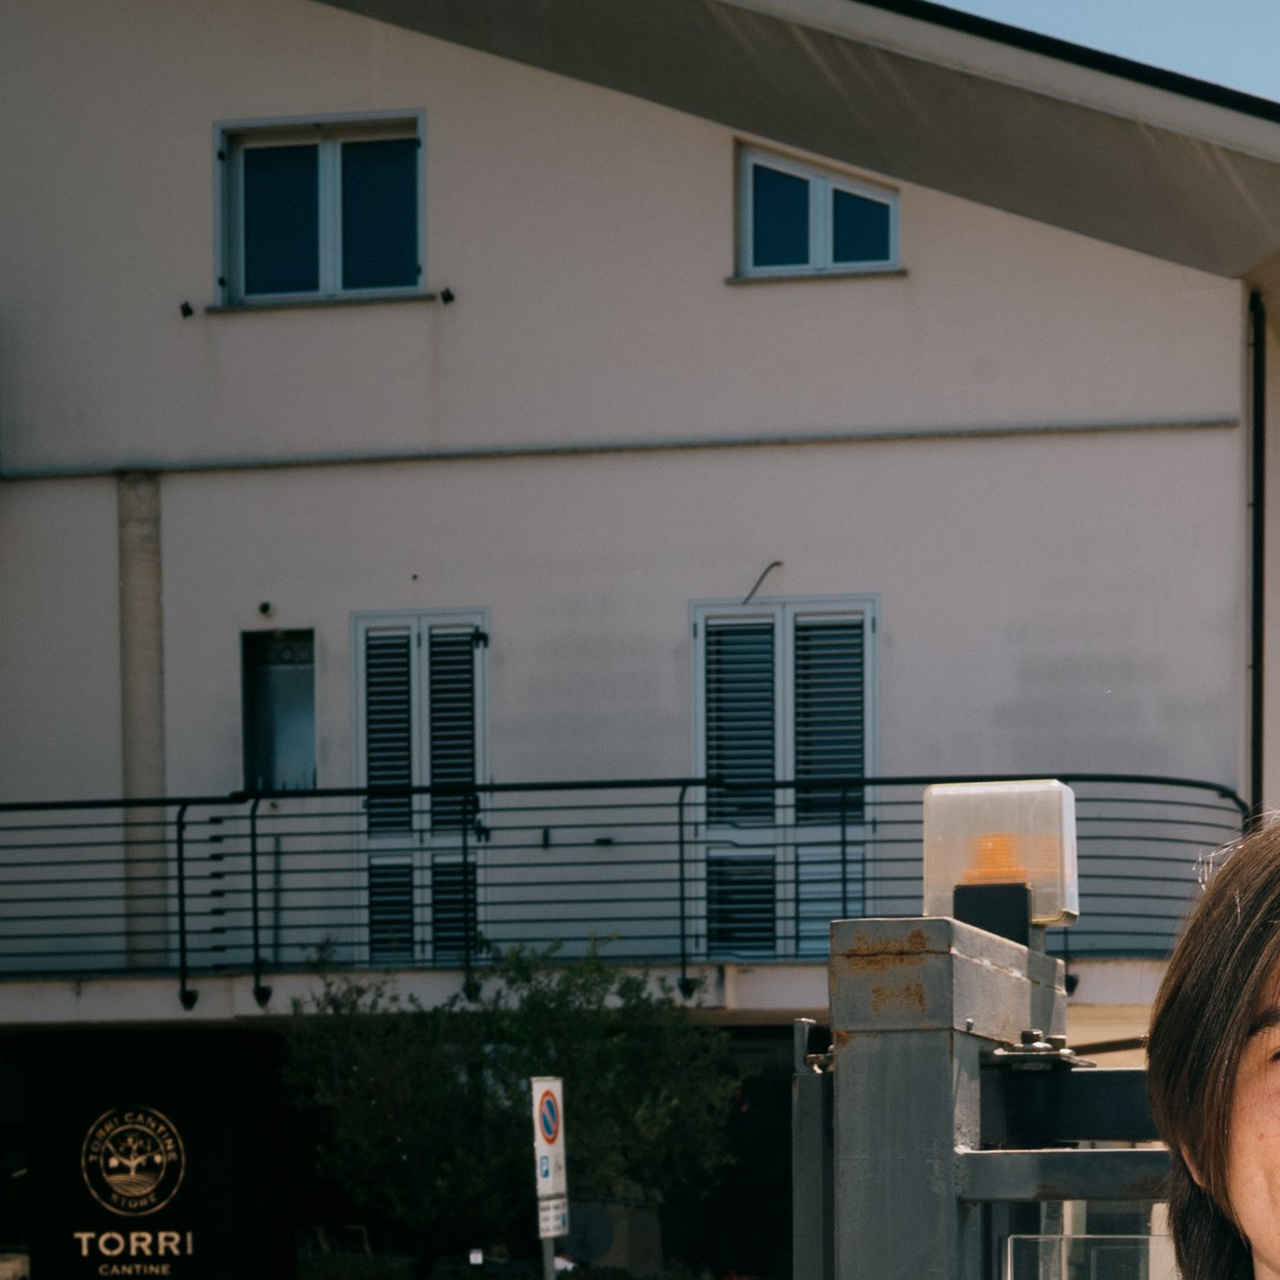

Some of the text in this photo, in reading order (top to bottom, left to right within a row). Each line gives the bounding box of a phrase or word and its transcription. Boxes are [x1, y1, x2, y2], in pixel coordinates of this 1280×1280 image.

[124, 1112, 178, 1162] CANTINE
[73, 1231, 193, 1257] TORRI
[98, 1264, 171, 1276] CANTINE
